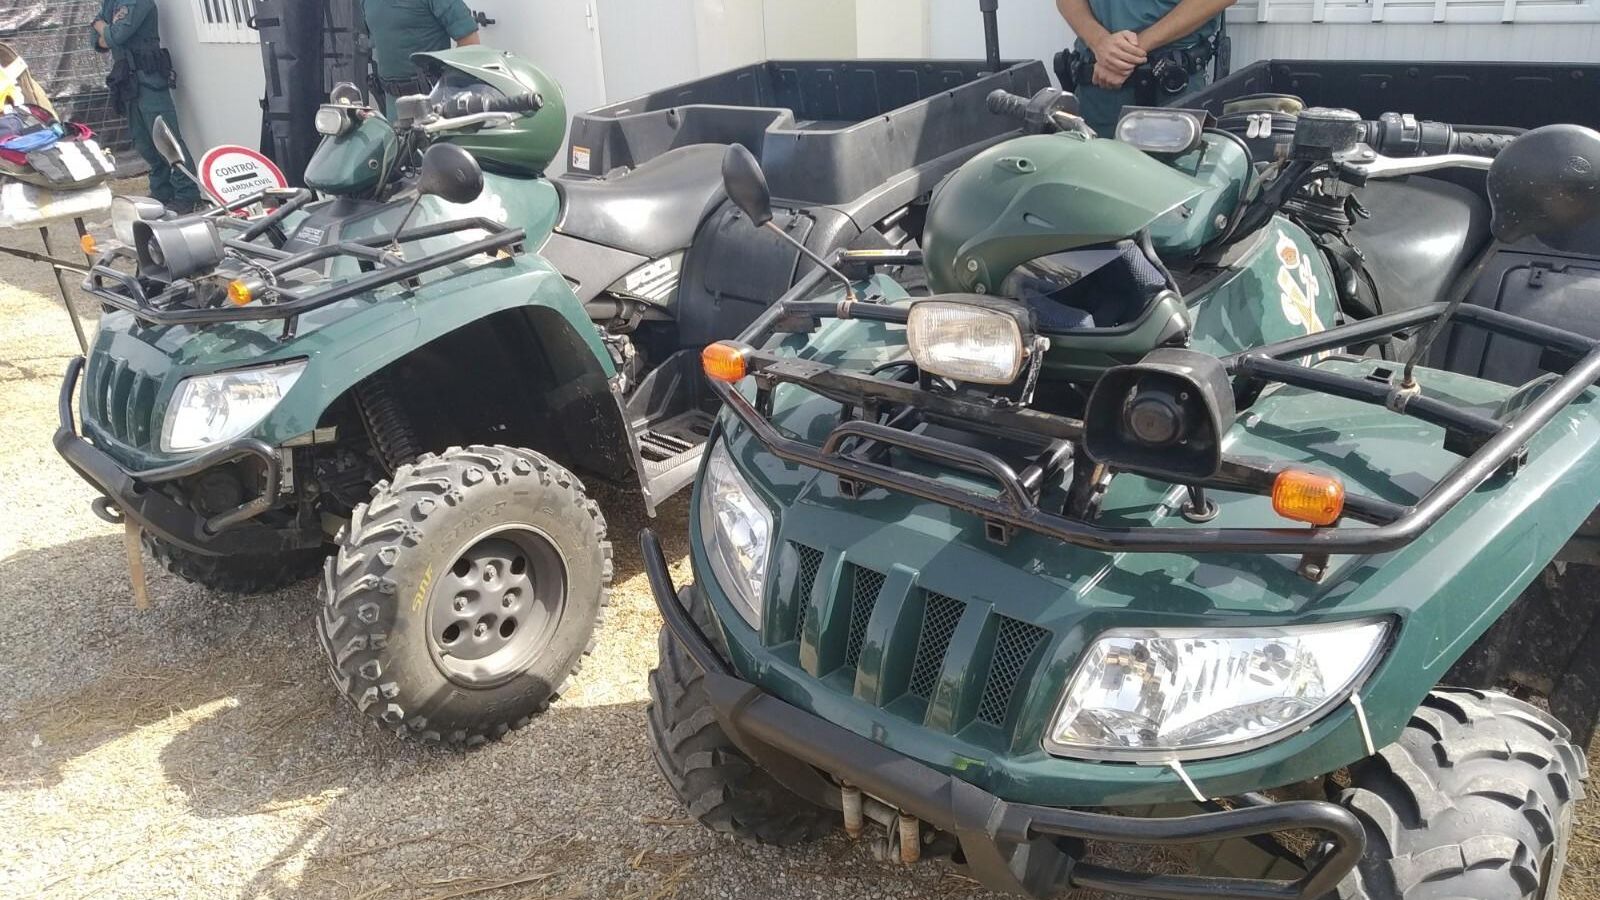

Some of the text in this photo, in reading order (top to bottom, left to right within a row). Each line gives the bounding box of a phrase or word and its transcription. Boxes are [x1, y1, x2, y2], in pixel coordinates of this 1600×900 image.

[215, 161, 259, 176] CONTROL
[221, 178, 273, 194] GUARDIA CIVIL
